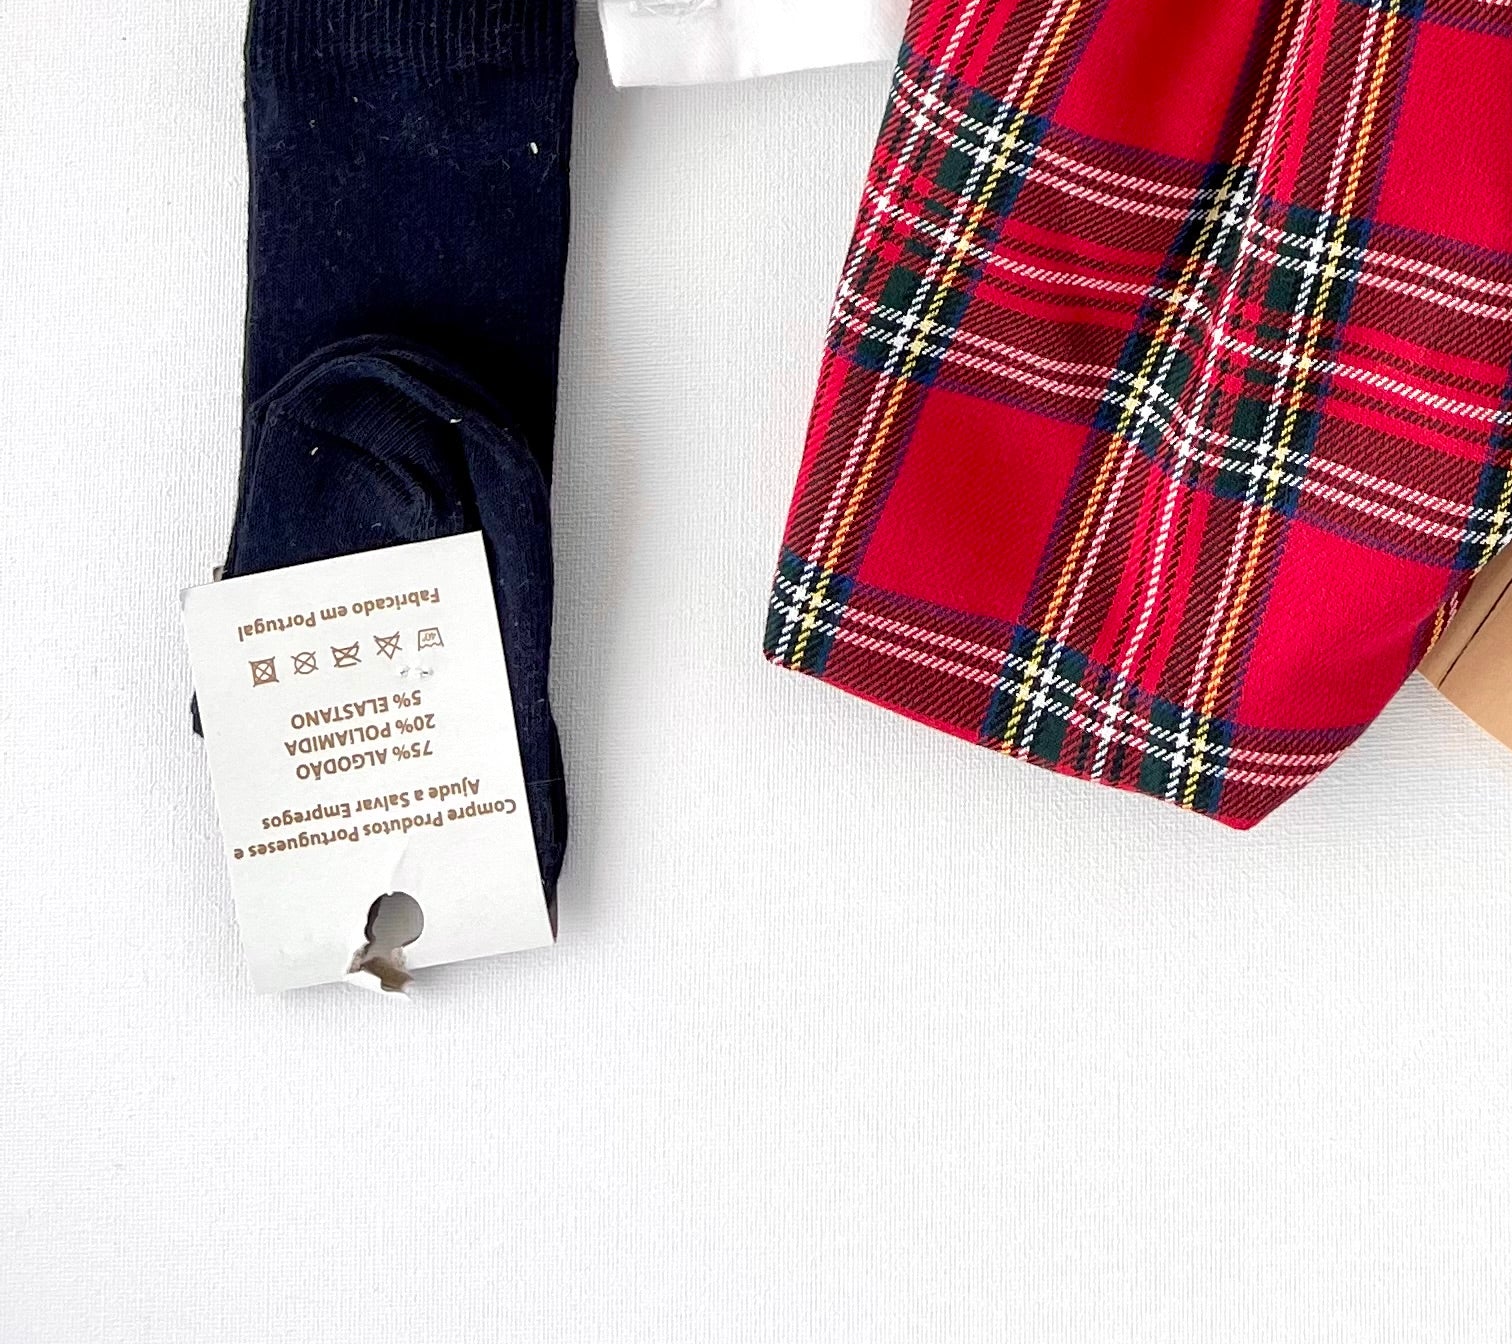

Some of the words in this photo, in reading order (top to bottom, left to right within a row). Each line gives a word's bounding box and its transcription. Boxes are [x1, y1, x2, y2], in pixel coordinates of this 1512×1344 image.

[319, 605, 348, 621] em
[351, 587, 441, 617] Fabricado
[237, 611, 317, 643] Portugal
[392, 689, 422, 709] 5%
[290, 696, 389, 730] ELASTANO
[395, 713, 436, 735] 20%
[283, 721, 392, 757] POLIAMIDA
[392, 739, 434, 762] 75%
[295, 747, 388, 781] ALGODÃO
[355, 791, 411, 813] Salvar
[413, 789, 424, 802] a
[428, 776, 480, 802] Ajude
[261, 802, 352, 830] Empregos
[447, 798, 517, 821] Compre
[362, 811, 444, 837] Produtos
[233, 848, 246, 861] e
[247, 826, 360, 858] Portugueses
